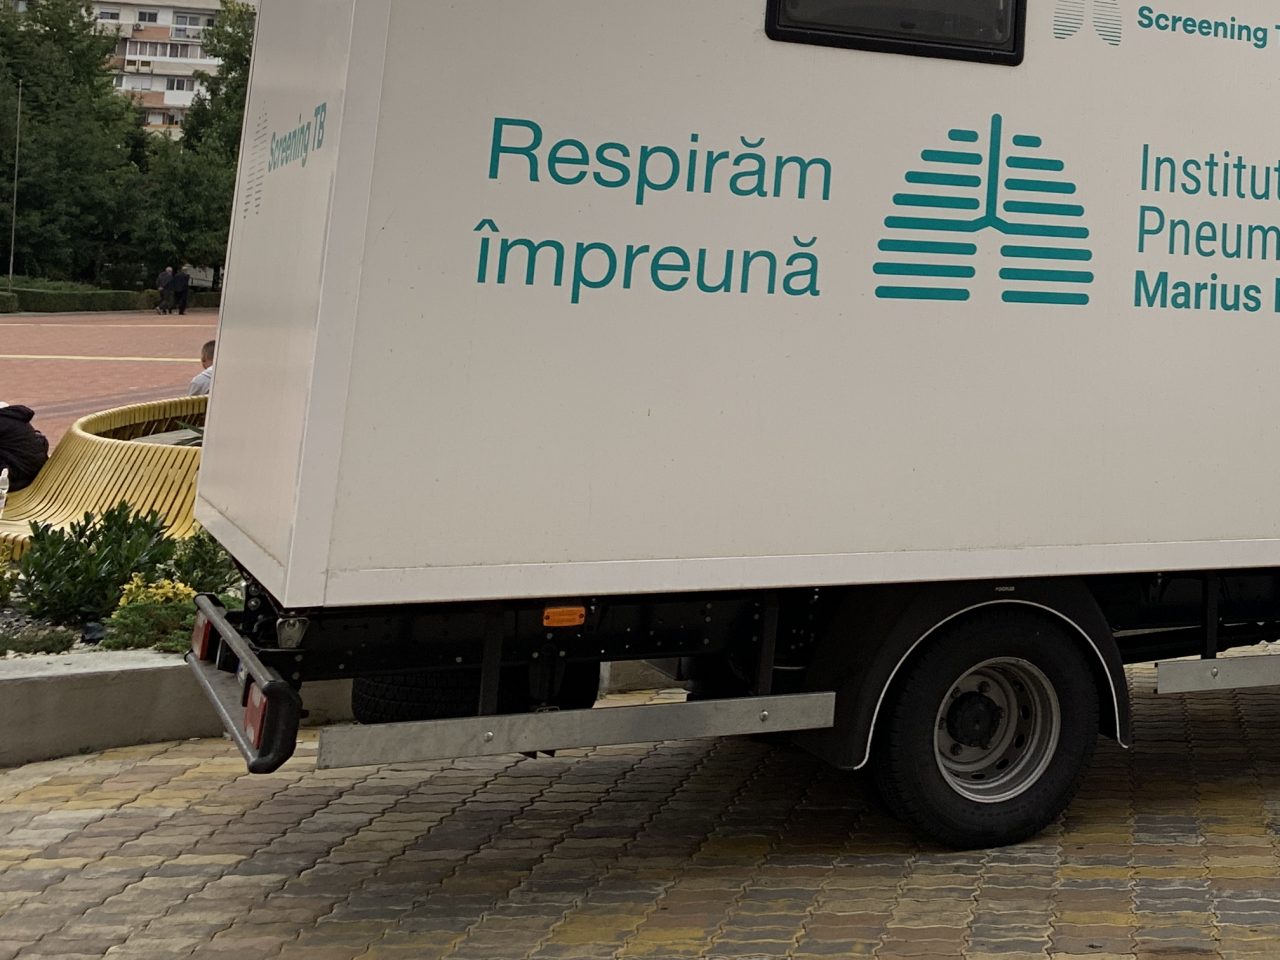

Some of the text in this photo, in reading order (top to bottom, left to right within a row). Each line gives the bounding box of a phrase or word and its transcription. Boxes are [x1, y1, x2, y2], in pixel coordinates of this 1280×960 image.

[1137, 5, 1268, 49] Screening
[268, 102, 327, 173] Screening TB
[488, 116, 833, 206] Respirăm
[473, 218, 820, 305] împreună
[1133, 270, 1262, 313] Marius
